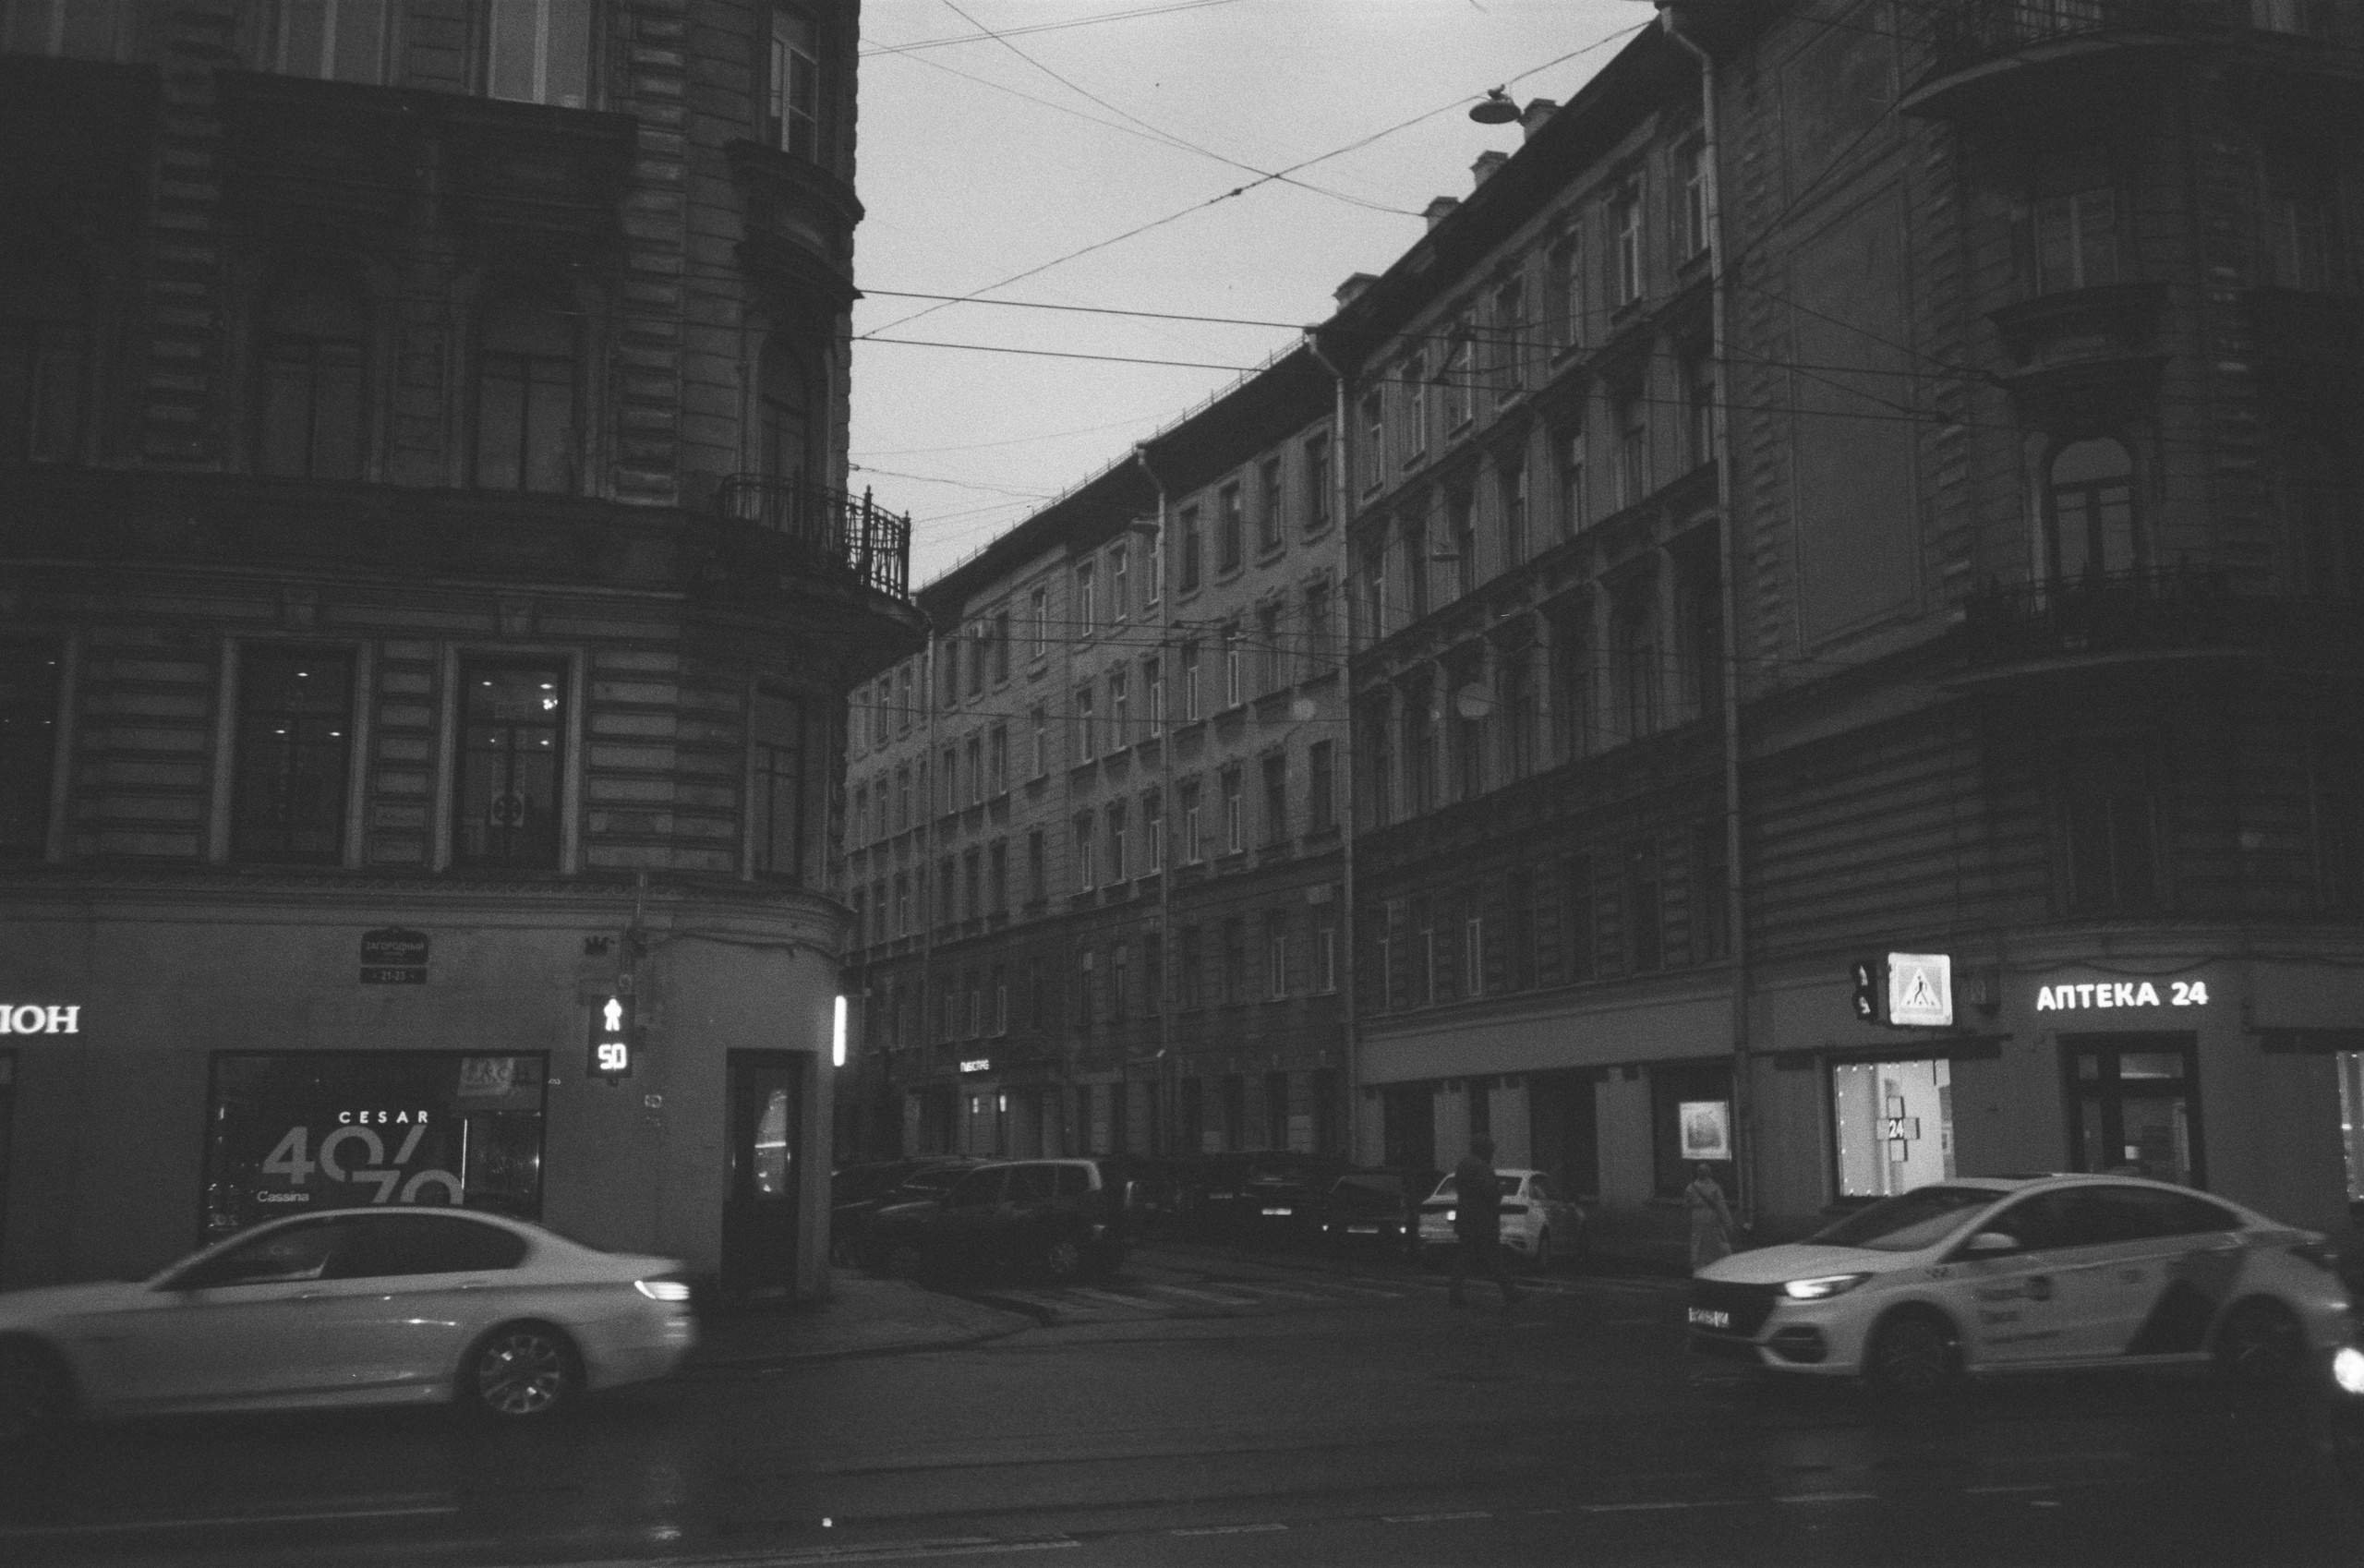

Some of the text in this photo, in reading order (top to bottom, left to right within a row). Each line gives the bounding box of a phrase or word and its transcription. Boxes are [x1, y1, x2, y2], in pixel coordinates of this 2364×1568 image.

[2037, 982, 2210, 1011] АПТЕКА 24
[338, 1111, 428, 1124] CESAR
[1888, 1119, 1904, 1138] 24
[257, 1190, 310, 1202] Cassina
